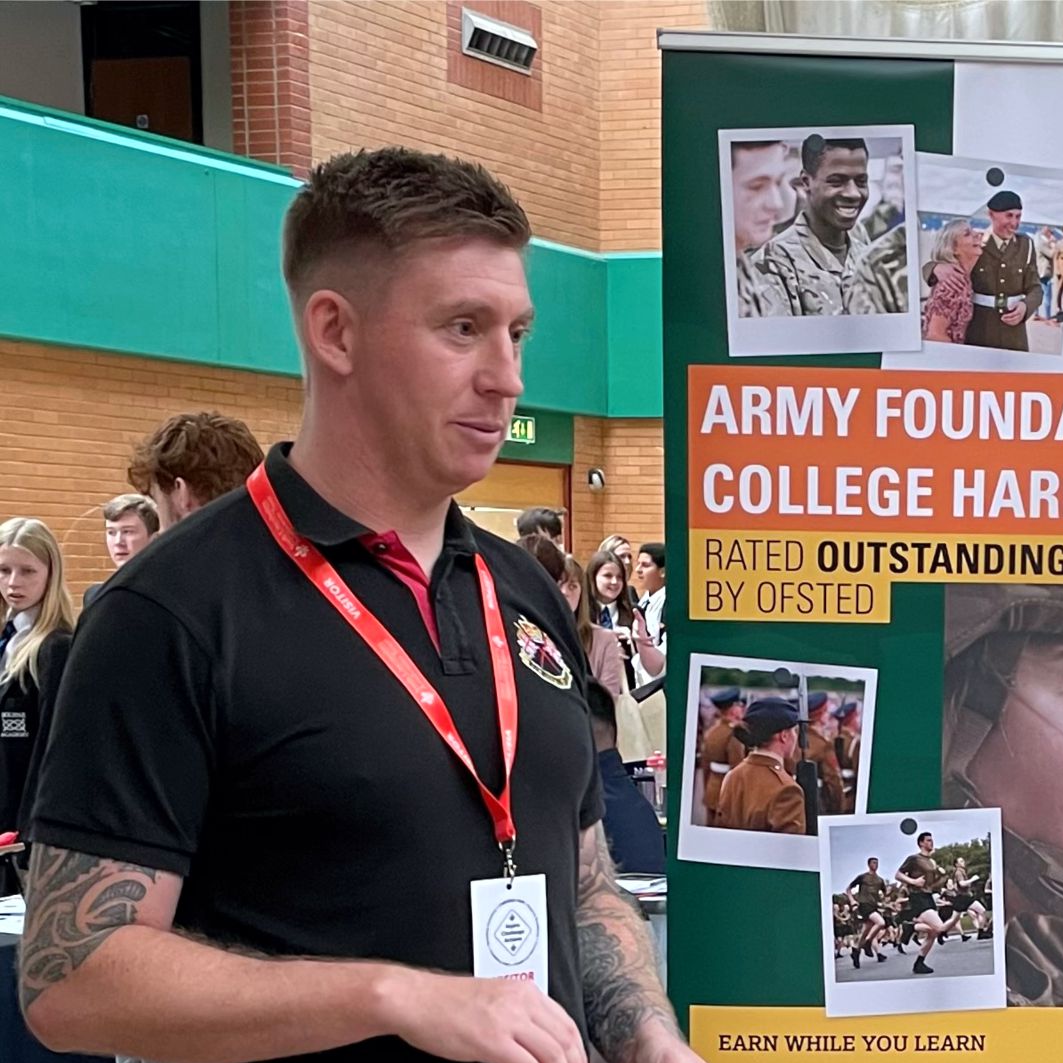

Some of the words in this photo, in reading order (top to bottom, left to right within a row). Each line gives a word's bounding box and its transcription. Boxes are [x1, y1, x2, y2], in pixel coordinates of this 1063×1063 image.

[701, 385, 860, 436] ARMY
[704, 464, 933, 516] COLLEGE
[706, 539, 803, 571] RATED
[323, 577, 361, 620] VISITOR
[707, 581, 744, 612] BY
[758, 582, 873, 614] OFSTED
[719, 1035, 778, 1051] EARN
[784, 1035, 855, 1051] WHILE
[862, 1036, 908, 1051] YOU
[915, 1035, 985, 1051] LEARN
